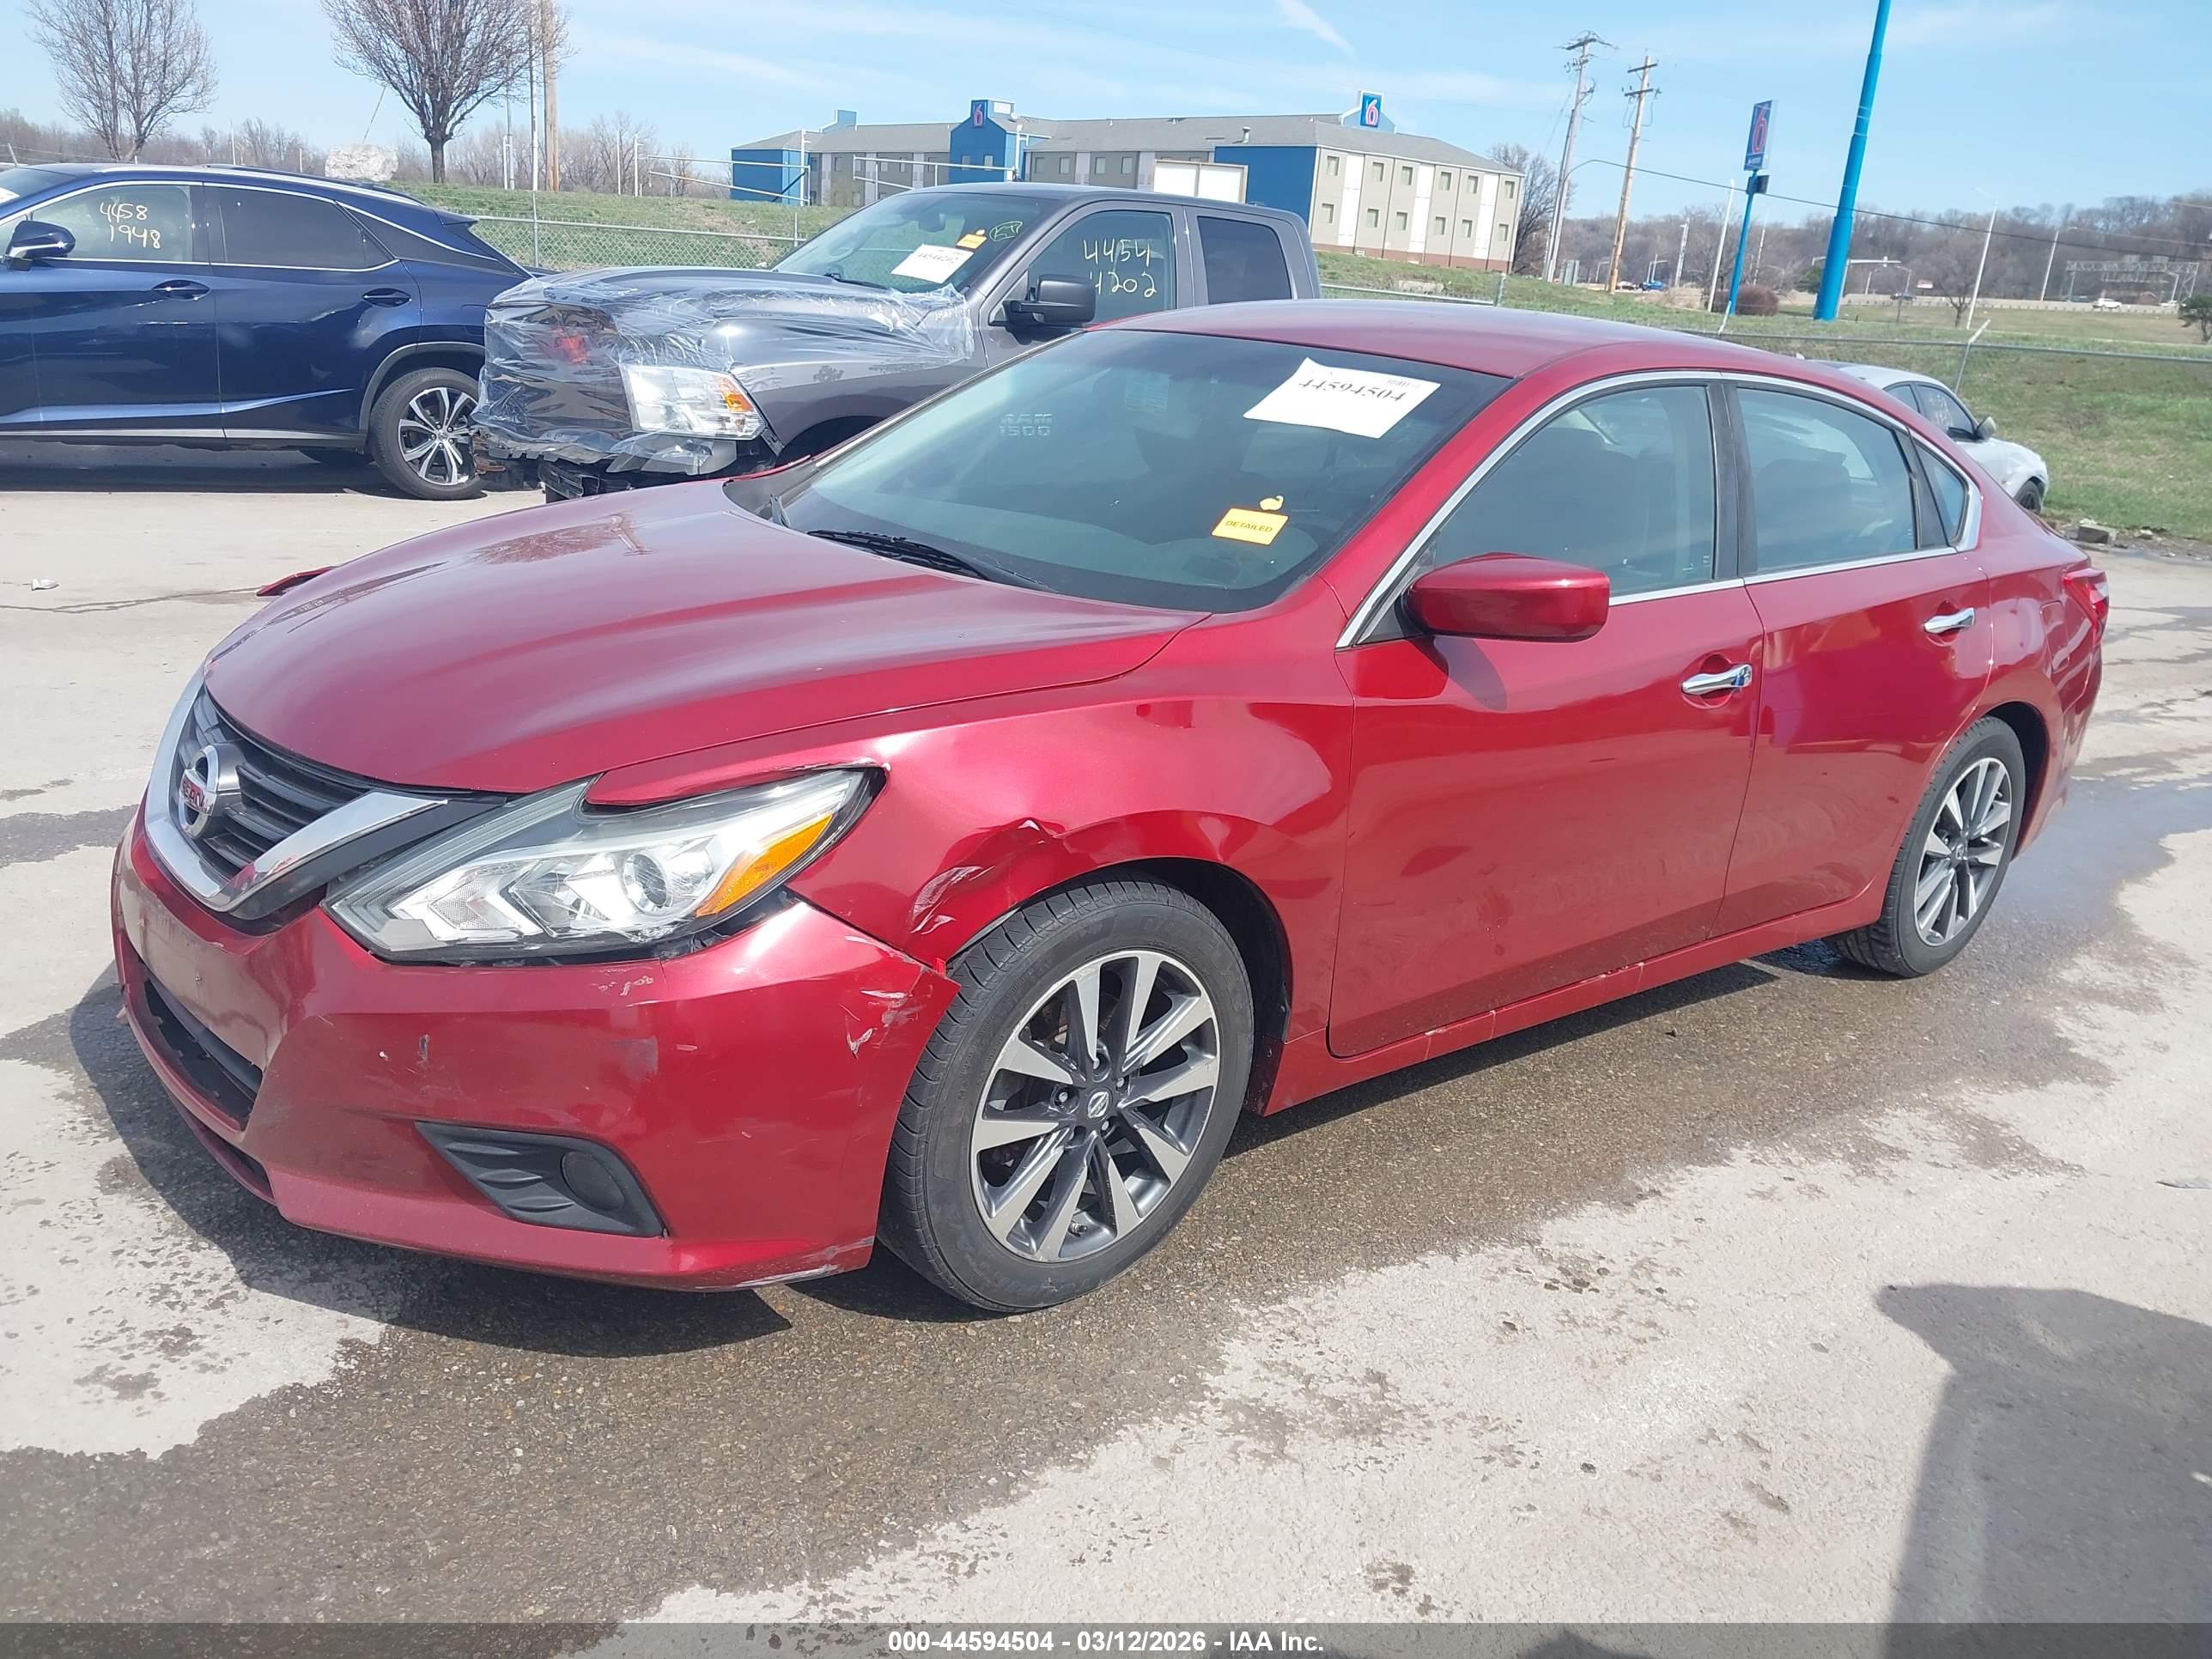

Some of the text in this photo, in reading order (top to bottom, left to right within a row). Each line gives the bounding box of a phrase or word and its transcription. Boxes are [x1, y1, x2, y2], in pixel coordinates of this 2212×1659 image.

[974, 103, 983, 127] 6
[1365, 98, 1379, 125] 6
[1752, 104, 1767, 154] 6
[100, 202, 148, 223] 4458
[109, 224, 161, 249] 1948
[1083, 238, 1152, 268] 4454
[1298, 379, 1407, 402] 44594504
[1225, 520, 1273, 532] DETAILED
